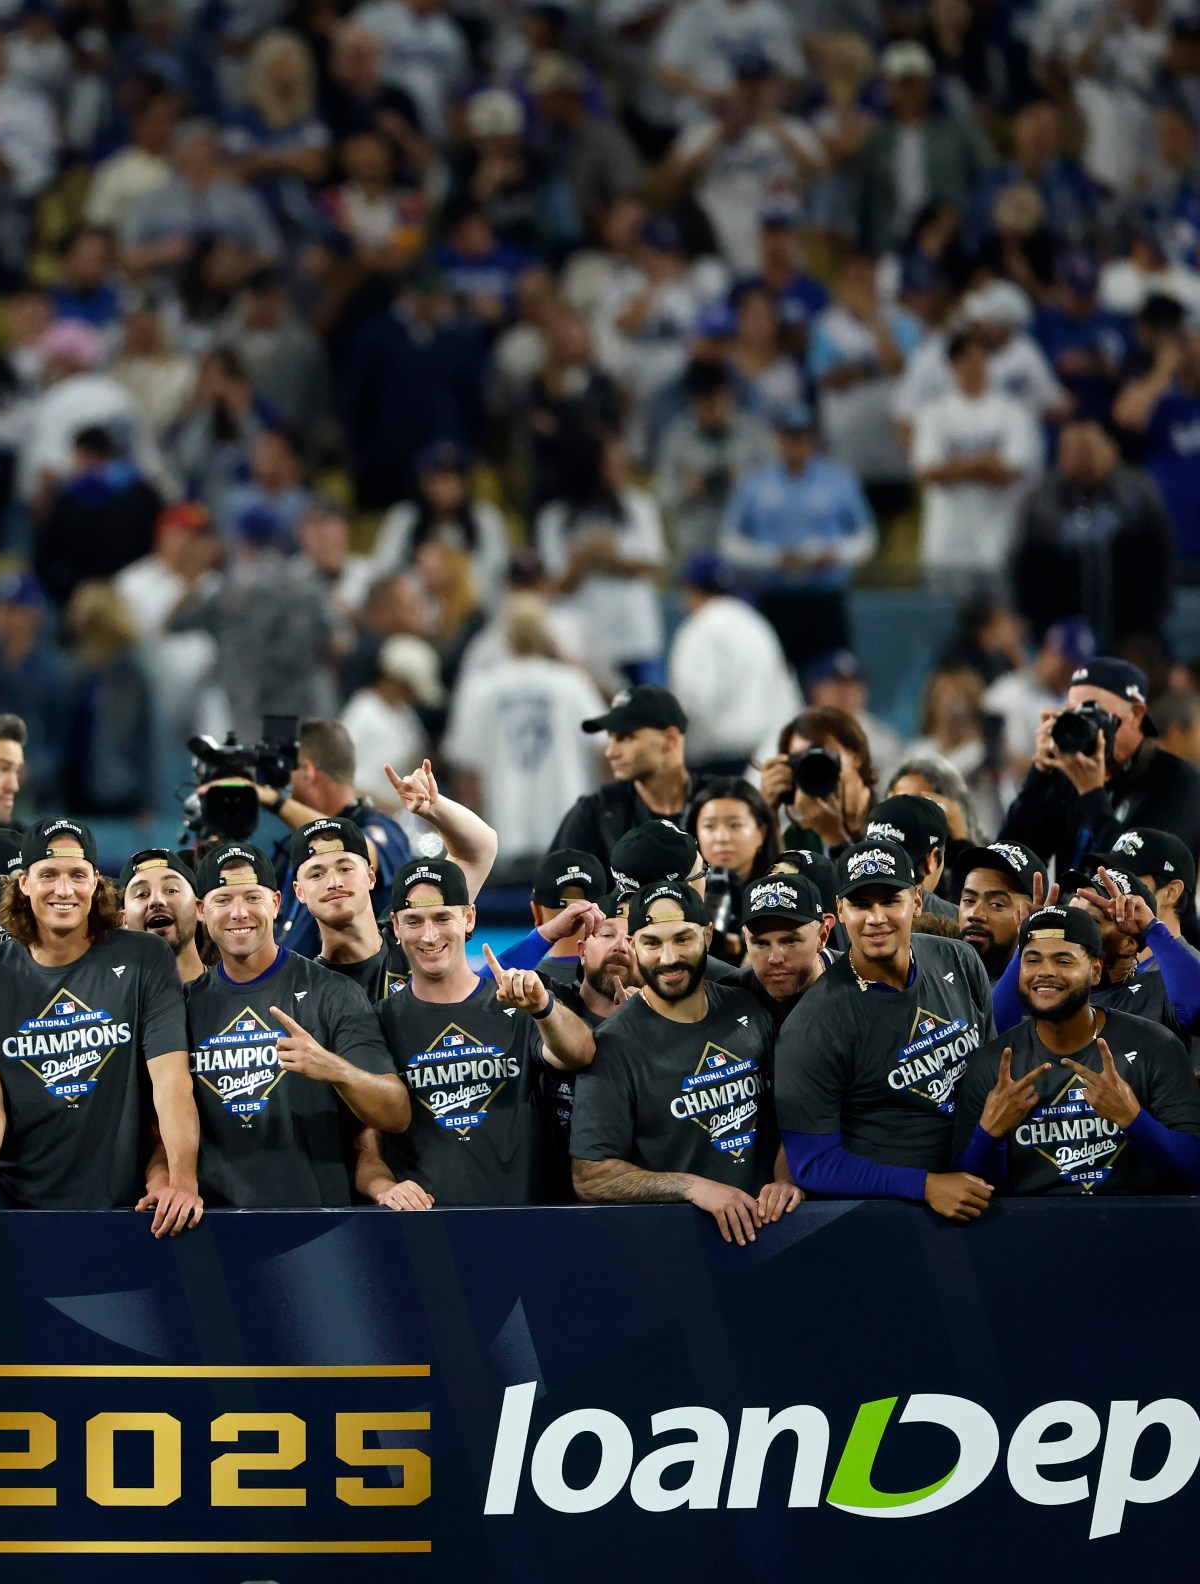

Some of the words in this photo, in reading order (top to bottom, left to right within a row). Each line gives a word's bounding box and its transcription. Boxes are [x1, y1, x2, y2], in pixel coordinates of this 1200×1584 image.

[44, 822, 62, 836] LEAGUE
[303, 823, 320, 837] LEAGUE
[884, 823, 905, 842] Series
[7, 856, 22, 868] LEAGU
[217, 850, 235, 865] LEAGUE
[847, 850, 873, 873] World
[872, 848, 896, 866] Series
[404, 871, 422, 885] LEAGUE
[422, 871, 442, 883] CHAMPS
[556, 873, 574, 886] LEAGUE
[574, 872, 592, 884] CHAMPS
[750, 882, 776, 904] World
[776, 881, 798, 900] Series
[28, 1018, 70, 1029] NATIONAL
[71, 1011, 103, 1024] LEAGUE
[209, 1034, 247, 1045] NATIONAL
[249, 1031, 281, 1042] LEAGUE
[935, 1021, 961, 1041] LEAGUE
[2, 1022, 132, 1058] CHAMPIONS
[417, 1050, 459, 1062] NATIONAL
[460, 1046, 495, 1057] LEAGUE
[41, 1050, 101, 1083] Dodgers
[406, 1057, 521, 1089] HAMPIONS
[688, 1071, 725, 1087] NATIONAL
[726, 1060, 752, 1077] LEAGUE
[55, 1083, 88, 1095] 2025
[217, 1068, 274, 1101] Dodgers
[429, 1082, 491, 1116] Dodgers
[231, 1102, 261, 1113] 2025
[1042, 1104, 1082, 1116] NATIONAL
[445, 1115, 479, 1127] 2025
[709, 1100, 758, 1138] Dodgers
[719, 1135, 751, 1150] 2025
[1055, 1138, 1117, 1172] Dodgers
[1071, 1170, 1104, 1182] 2025
